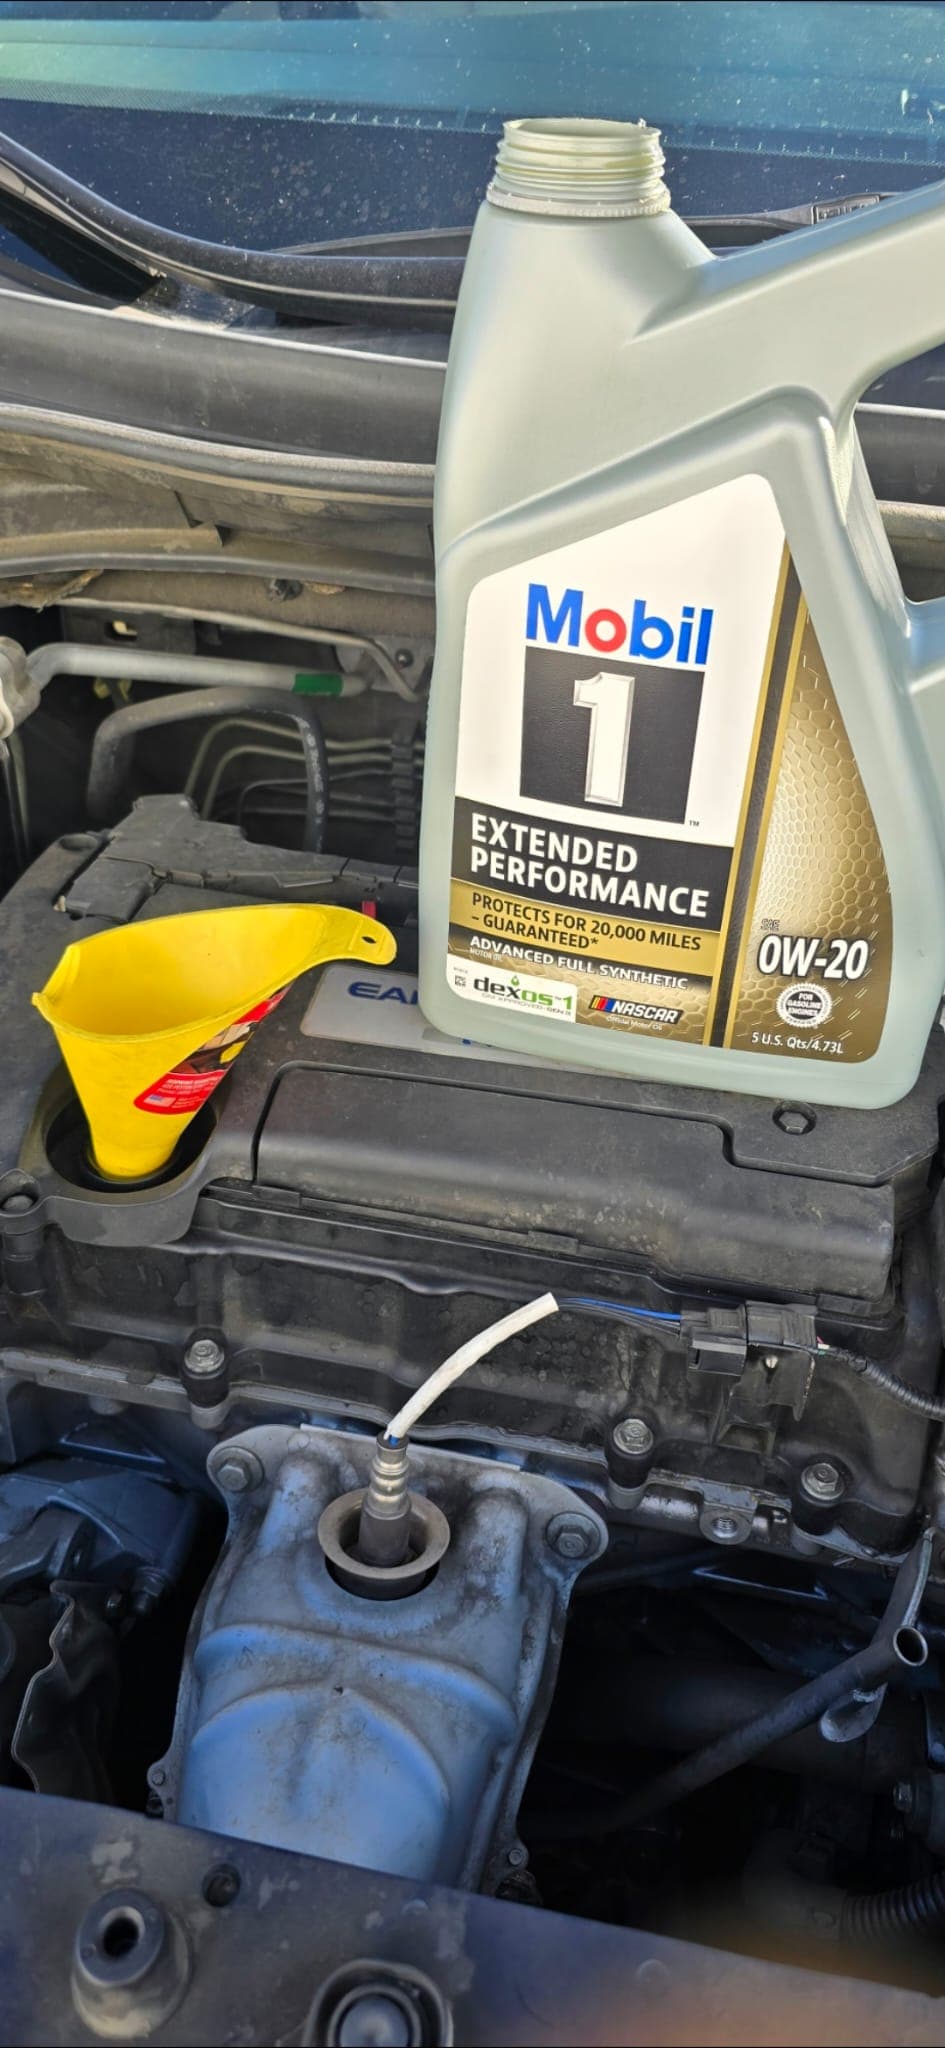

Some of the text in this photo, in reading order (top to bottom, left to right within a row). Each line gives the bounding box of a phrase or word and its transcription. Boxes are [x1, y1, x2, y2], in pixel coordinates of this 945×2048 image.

[526, 583, 714, 665] Mobil
[573, 671, 636, 807] 1
[471, 812, 639, 874] EXTENDED
[471, 845, 711, 918] PERFORMANCE
[472, 892, 701, 951] PROTECTS FOR 20,000 MILES
[469, 935, 689, 990] ADVANCED FULL SYNTHETIC
[758, 935, 869, 980] 0W-20
[611, 1000, 679, 1023] NASCAR
[798, 993, 814, 1001] FOR
[752, 1032, 844, 1054] 5 U.S. Qts/4.73L
